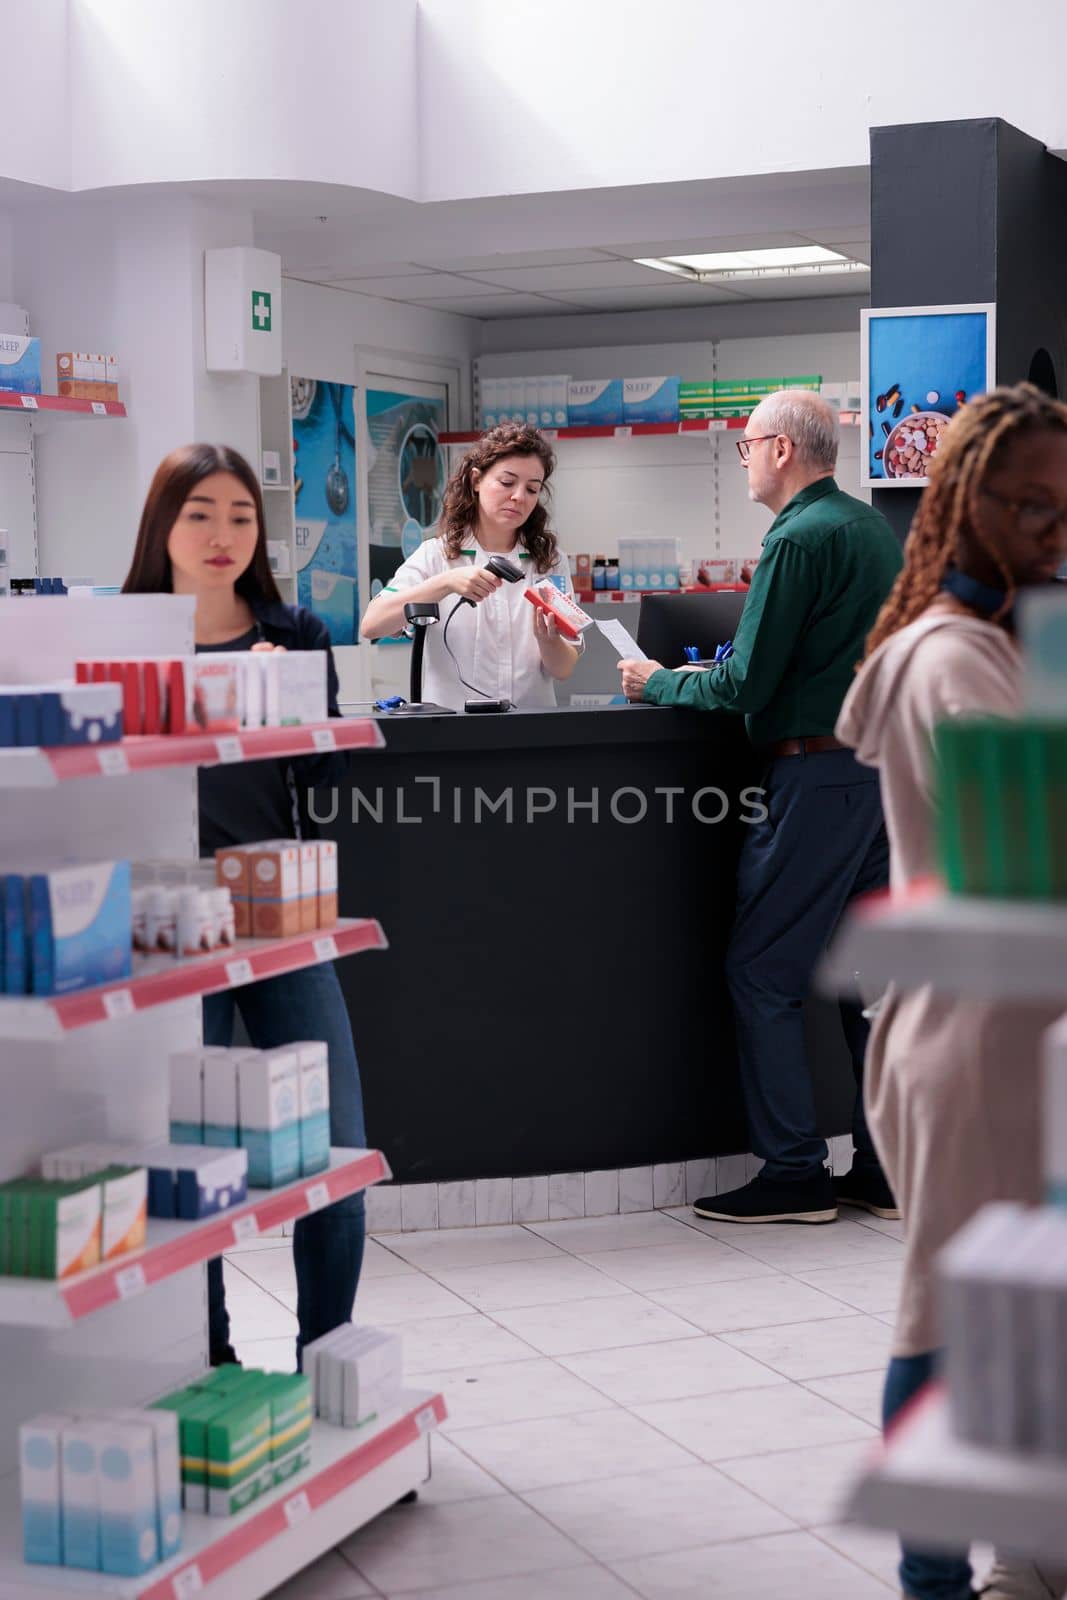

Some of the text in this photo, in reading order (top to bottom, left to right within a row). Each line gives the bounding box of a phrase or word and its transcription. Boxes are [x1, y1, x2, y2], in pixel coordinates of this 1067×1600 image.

[570, 385, 597, 395] SLEEP
[625, 382, 652, 392] SLEEP
[295, 527, 310, 546] EP
